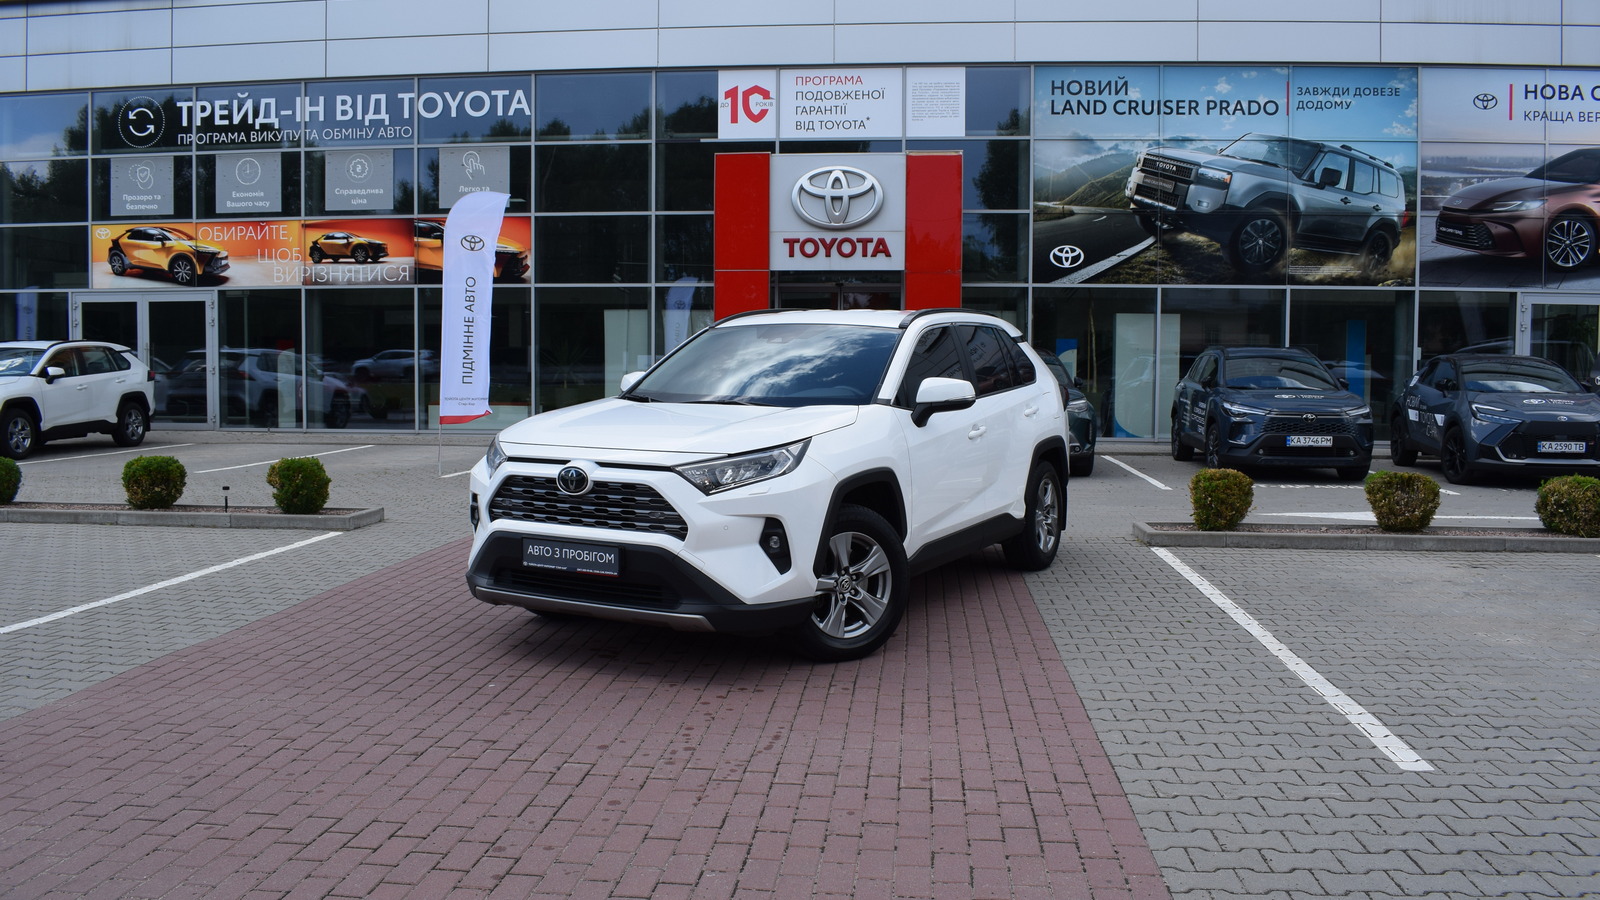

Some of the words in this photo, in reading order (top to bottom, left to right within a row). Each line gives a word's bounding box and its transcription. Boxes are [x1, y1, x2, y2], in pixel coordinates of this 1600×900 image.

[795, 75, 863, 86] ПРОГРАМА
[1051, 76, 1129, 96] НОВИЙ
[795, 88, 886, 103] ПОДОВЖЕНОЇ
[1297, 87, 1350, 98] ЗАВЖДИ
[1353, 87, 1400, 98] ДОВЕЗЕ
[1524, 84, 1585, 101] НОВА
[176, 92, 325, 130] ТРЕЙД-ІН
[336, 93, 390, 126] ВІД
[397, 89, 532, 119] TOYOTA
[795, 103, 848, 115] ГАРАНТІЇ
[1051, 99, 1107, 116] LAND
[1113, 99, 1200, 116] CRUISER
[1206, 99, 1280, 116] PRADO
[1296, 100, 1352, 112] ДОДОМУ
[1523, 110, 1575, 124] КРАЩА
[795, 120, 815, 131] ВІД
[177, 131, 247, 145] ПРОГРАМА
[250, 129, 300, 143] ВИКУПУ
[303, 128, 319, 141] ТА
[322, 127, 375, 141] ОБМІНУ
[377, 126, 412, 138] АВТО
[1156, 161, 1177, 171] TOYOTA
[231, 190, 264, 198] Економія
[334, 187, 384, 196] Справедлива
[458, 184, 481, 193] Легко
[122, 194, 152, 203] Прозоро
[254, 200, 270, 208] часу
[351, 198, 367, 206] ціна
[198, 222, 293, 242] ОБИРАЙТЕ,
[783, 237, 892, 258] TOYOTA
[257, 248, 302, 264] ЩОБ
[273, 265, 410, 283] ВИРІЗНЯТИСЯ
[464, 276, 476, 313] АВТО
[462, 316, 475, 384] ПІДМІННЕ
[1290, 436, 1301, 445] KA
[1303, 436, 1319, 445] 3746
[1320, 436, 1332, 445] PM
[527, 545, 552, 557] АВТО
[562, 548, 615, 564] ПРОБІГОМ
